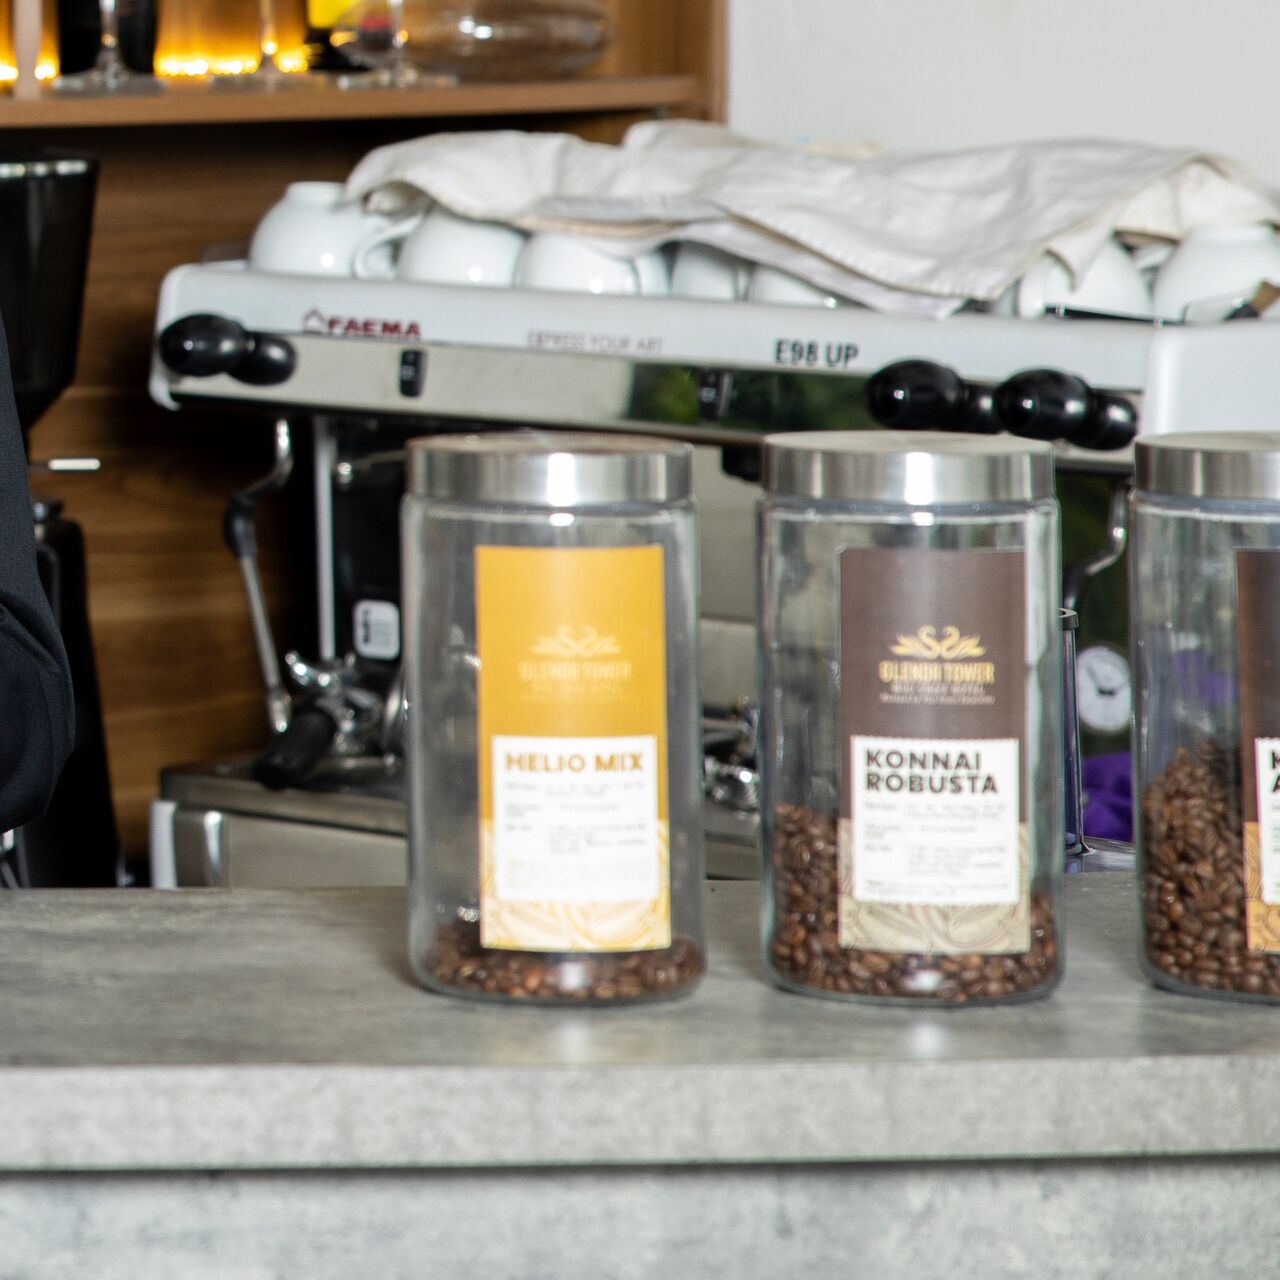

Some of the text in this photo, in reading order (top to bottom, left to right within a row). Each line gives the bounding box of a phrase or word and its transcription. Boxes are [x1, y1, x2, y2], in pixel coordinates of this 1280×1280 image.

[328, 317, 421, 337] FAEMA
[775, 339, 858, 366] E98 UP
[505, 752, 644, 773] HELIO MIX
[864, 748, 982, 771] KONNAI
[865, 773, 998, 794] ROBUSTA
